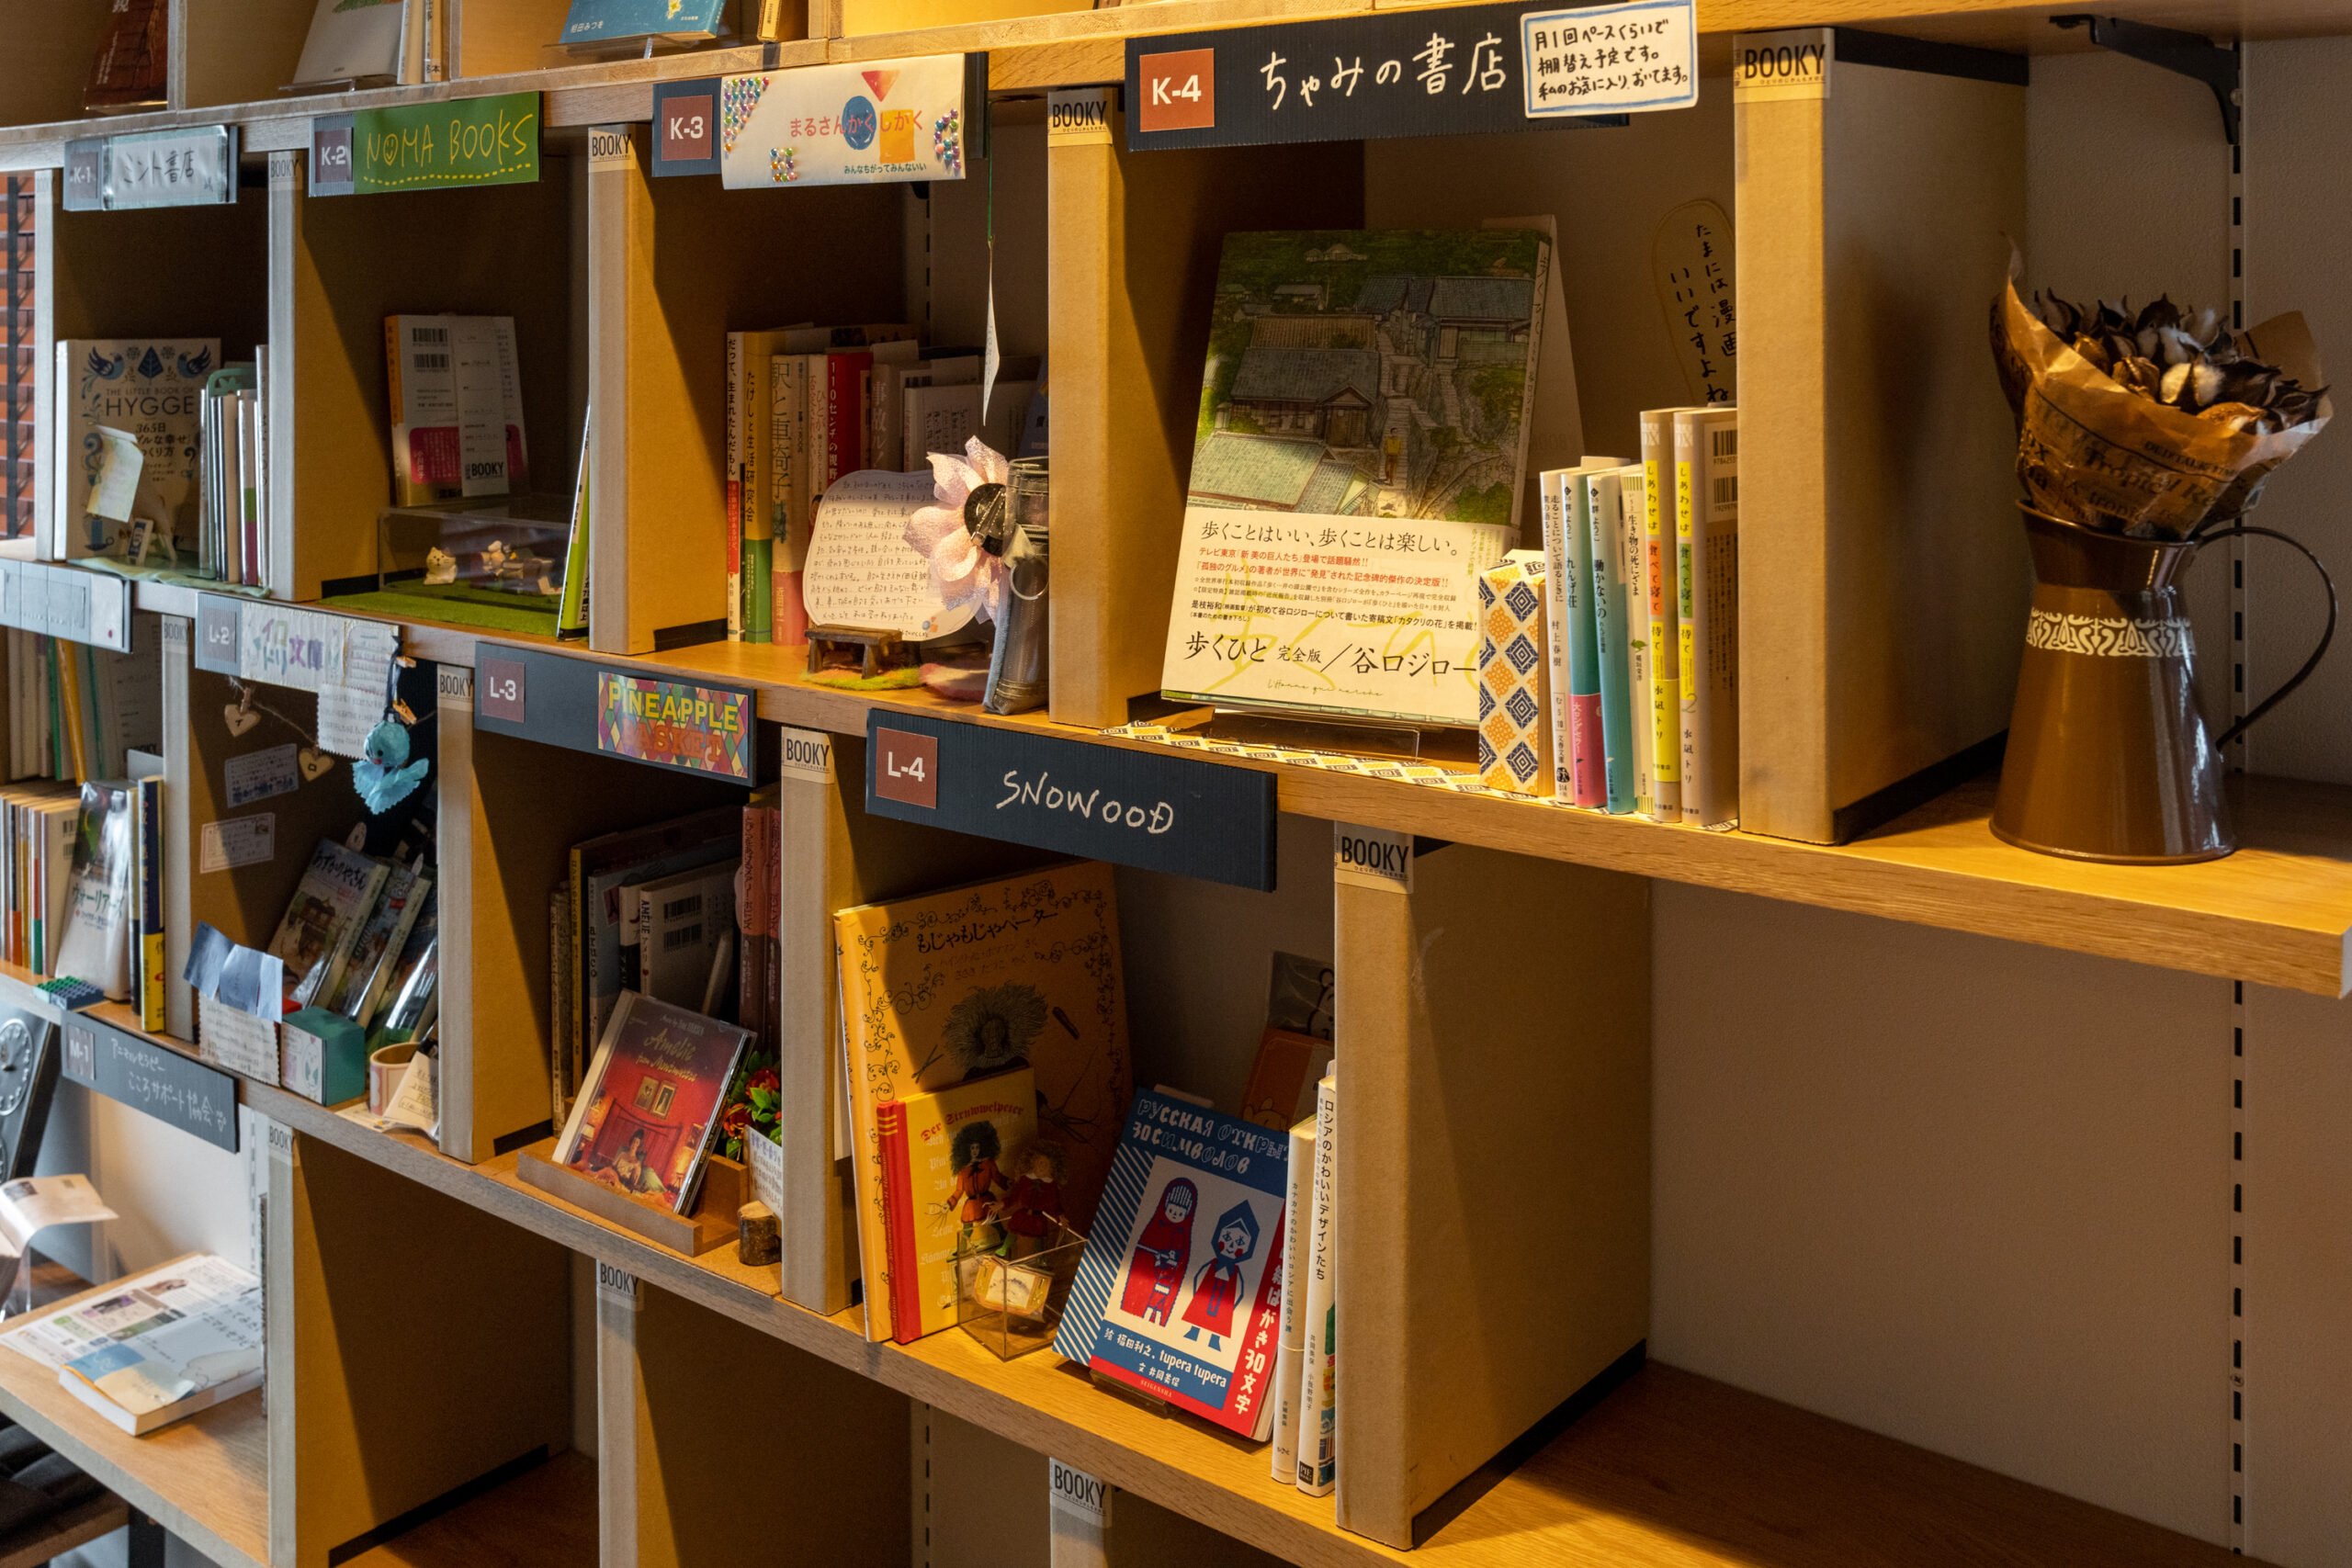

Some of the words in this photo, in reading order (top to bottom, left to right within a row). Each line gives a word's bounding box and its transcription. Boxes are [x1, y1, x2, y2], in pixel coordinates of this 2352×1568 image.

[1260, 32, 1507, 111] ちゃみの書店
[1537, 45, 1659, 76] 棚替え予定です。
[1745, 44, 1826, 80] BOOKY
[1151, 79, 1202, 107] K-4
[670, 116, 704, 140] K-3
[790, 109, 923, 139] まるさんかくしかく
[1052, 101, 1107, 129] BOOKY
[322, 145, 346, 166] K-2
[367, 125, 434, 170] NOMA
[449, 109, 533, 165] BOOKS
[592, 133, 632, 157] BOOKY
[270, 158, 299, 178] BOOKY
[843, 163, 927, 175] みんなちがってみんないい
[1670, 267, 1729, 401] いいですよね
[106, 397, 195, 416] HYGGE
[744, 371, 756, 523] たけしと生活研究会
[470, 462, 504, 477] BOOKY
[1646, 465, 1658, 532] しあわせは
[1679, 466, 1691, 535] しあわせは
[1200, 520, 1458, 557] 歩くことはいい、歩くことは楽しい。
[1551, 494, 1564, 603] 走ることについて語るときに
[1627, 514, 1640, 597] 生き物の死にざま
[1566, 558, 1579, 609] れんげ荘
[1593, 558, 1608, 620] 働かないの
[1649, 543, 1661, 614] 食べて寝て
[1680, 545, 1692, 615] 食べて寝て
[209, 625, 230, 646] L-2
[1184, 631, 1267, 663] 歩くひと
[1277, 644, 1322, 664] 完全版
[1552, 620, 1562, 668] 村上春樹
[1651, 626, 1664, 651] 待て
[1680, 626, 1693, 654] 待て
[439, 673, 474, 697] BOOKY
[489, 676, 516, 701] L-3
[1681, 692, 1698, 714] 2
[607, 681, 740, 733] PINEAPPLE
[623, 712, 723, 762] BASKET
[786, 738, 830, 766] BOOKY
[887, 750, 926, 783] L-4
[1683, 729, 1693, 784] 水凪トリ
[995, 770, 1174, 835] SNOWOOD
[312, 851, 367, 892] あずかりやさん
[1341, 836, 1409, 873] BOOKY
[917, 908, 1058, 953] もじゃもじゃペーター
[69, 1039, 89, 1063] M-1
[110, 1037, 166, 1072] アニマルセラピー
[128, 1071, 214, 1127] こころサポート協会
[1136, 1098, 1215, 1137] РУССКАЯ
[1316, 1099, 1335, 1280] ロシアのかわいいデザインたち
[600, 1262, 639, 1296] BOOKY
[1159, 1348, 1192, 1372] tupera
[1193, 1365, 1228, 1388] tupera
[1054, 1463, 1107, 1508] BOOKY
